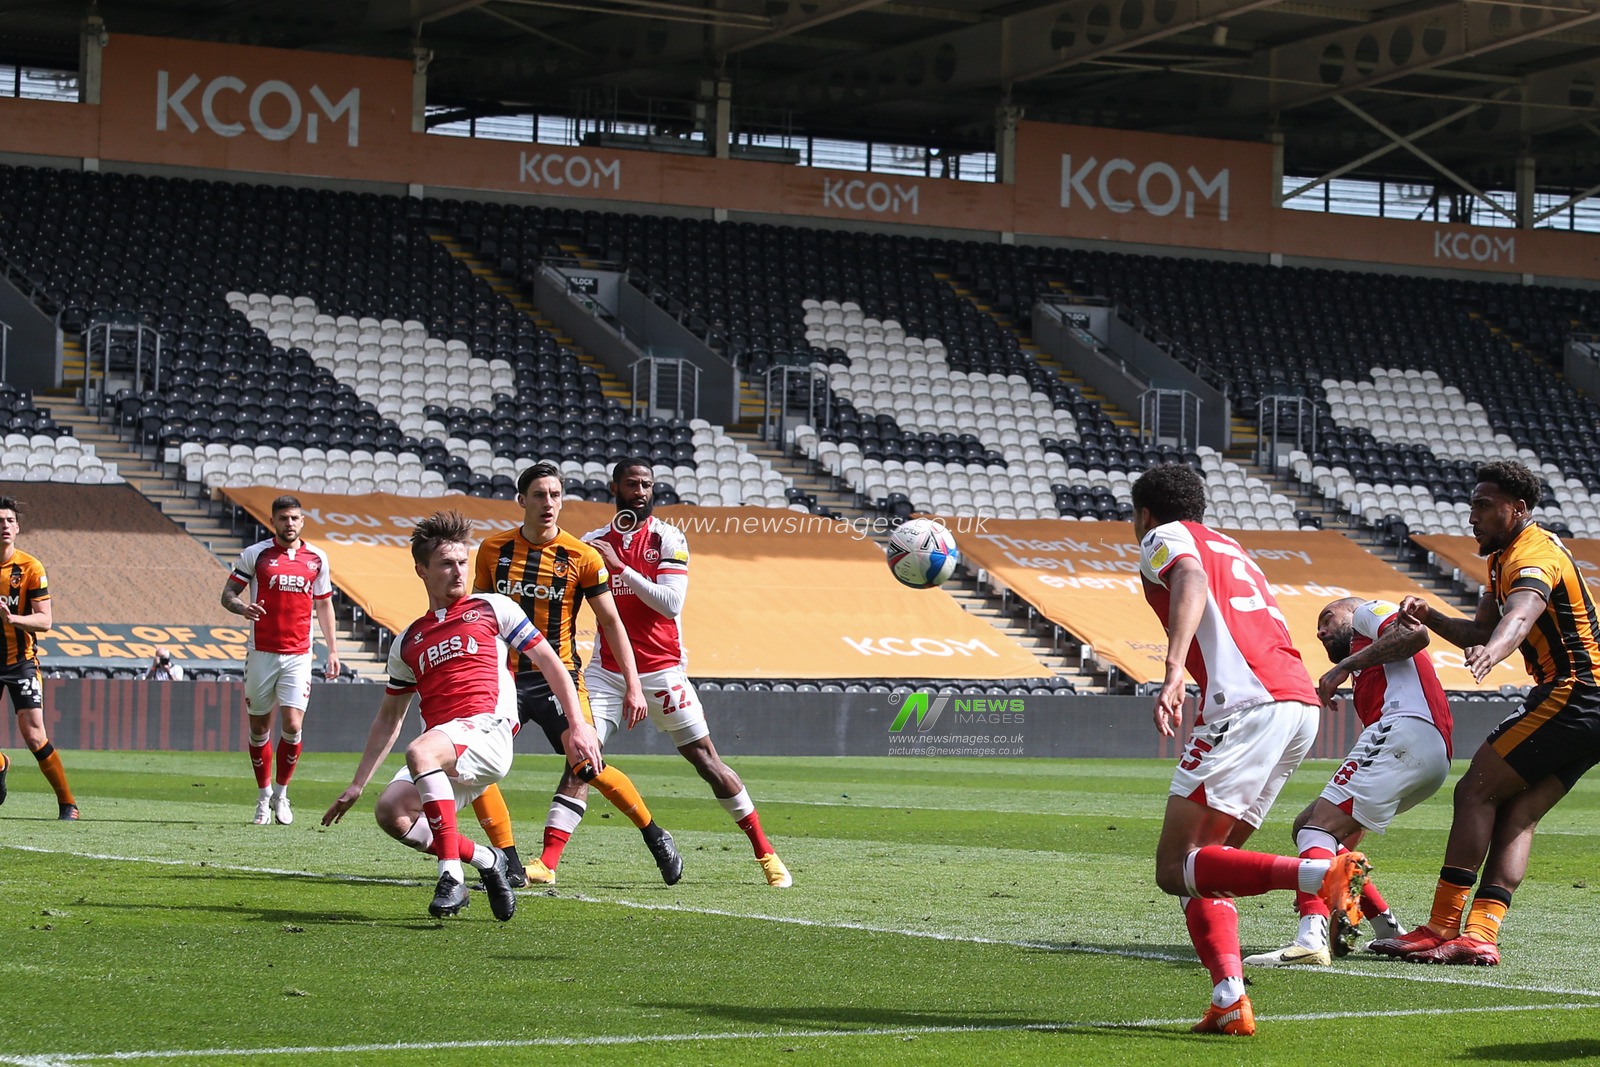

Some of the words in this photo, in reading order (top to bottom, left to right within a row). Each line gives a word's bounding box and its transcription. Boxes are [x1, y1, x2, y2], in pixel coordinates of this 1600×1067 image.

[156, 70, 360, 148] KCOM
[519, 151, 621, 191] KCOM
[823, 177, 920, 216] KCOM
[1060, 153, 1230, 222] KCOM
[1433, 230, 1516, 264] KCOM
[303, 508, 382, 527] You
[975, 534, 1101, 553] Thank
[1100, 542, 1142, 557] yo
[1003, 552, 1076, 573] key
[279, 574, 305, 587] BES
[37, 625, 125, 642] ALL
[131, 626, 197, 643] OF
[57, 642, 248, 661] PARTNE
[427, 635, 463, 662] BES
[841, 636, 999, 657] KCOM
[17, 676, 42, 696] 24
[654, 684, 692, 715] 22
